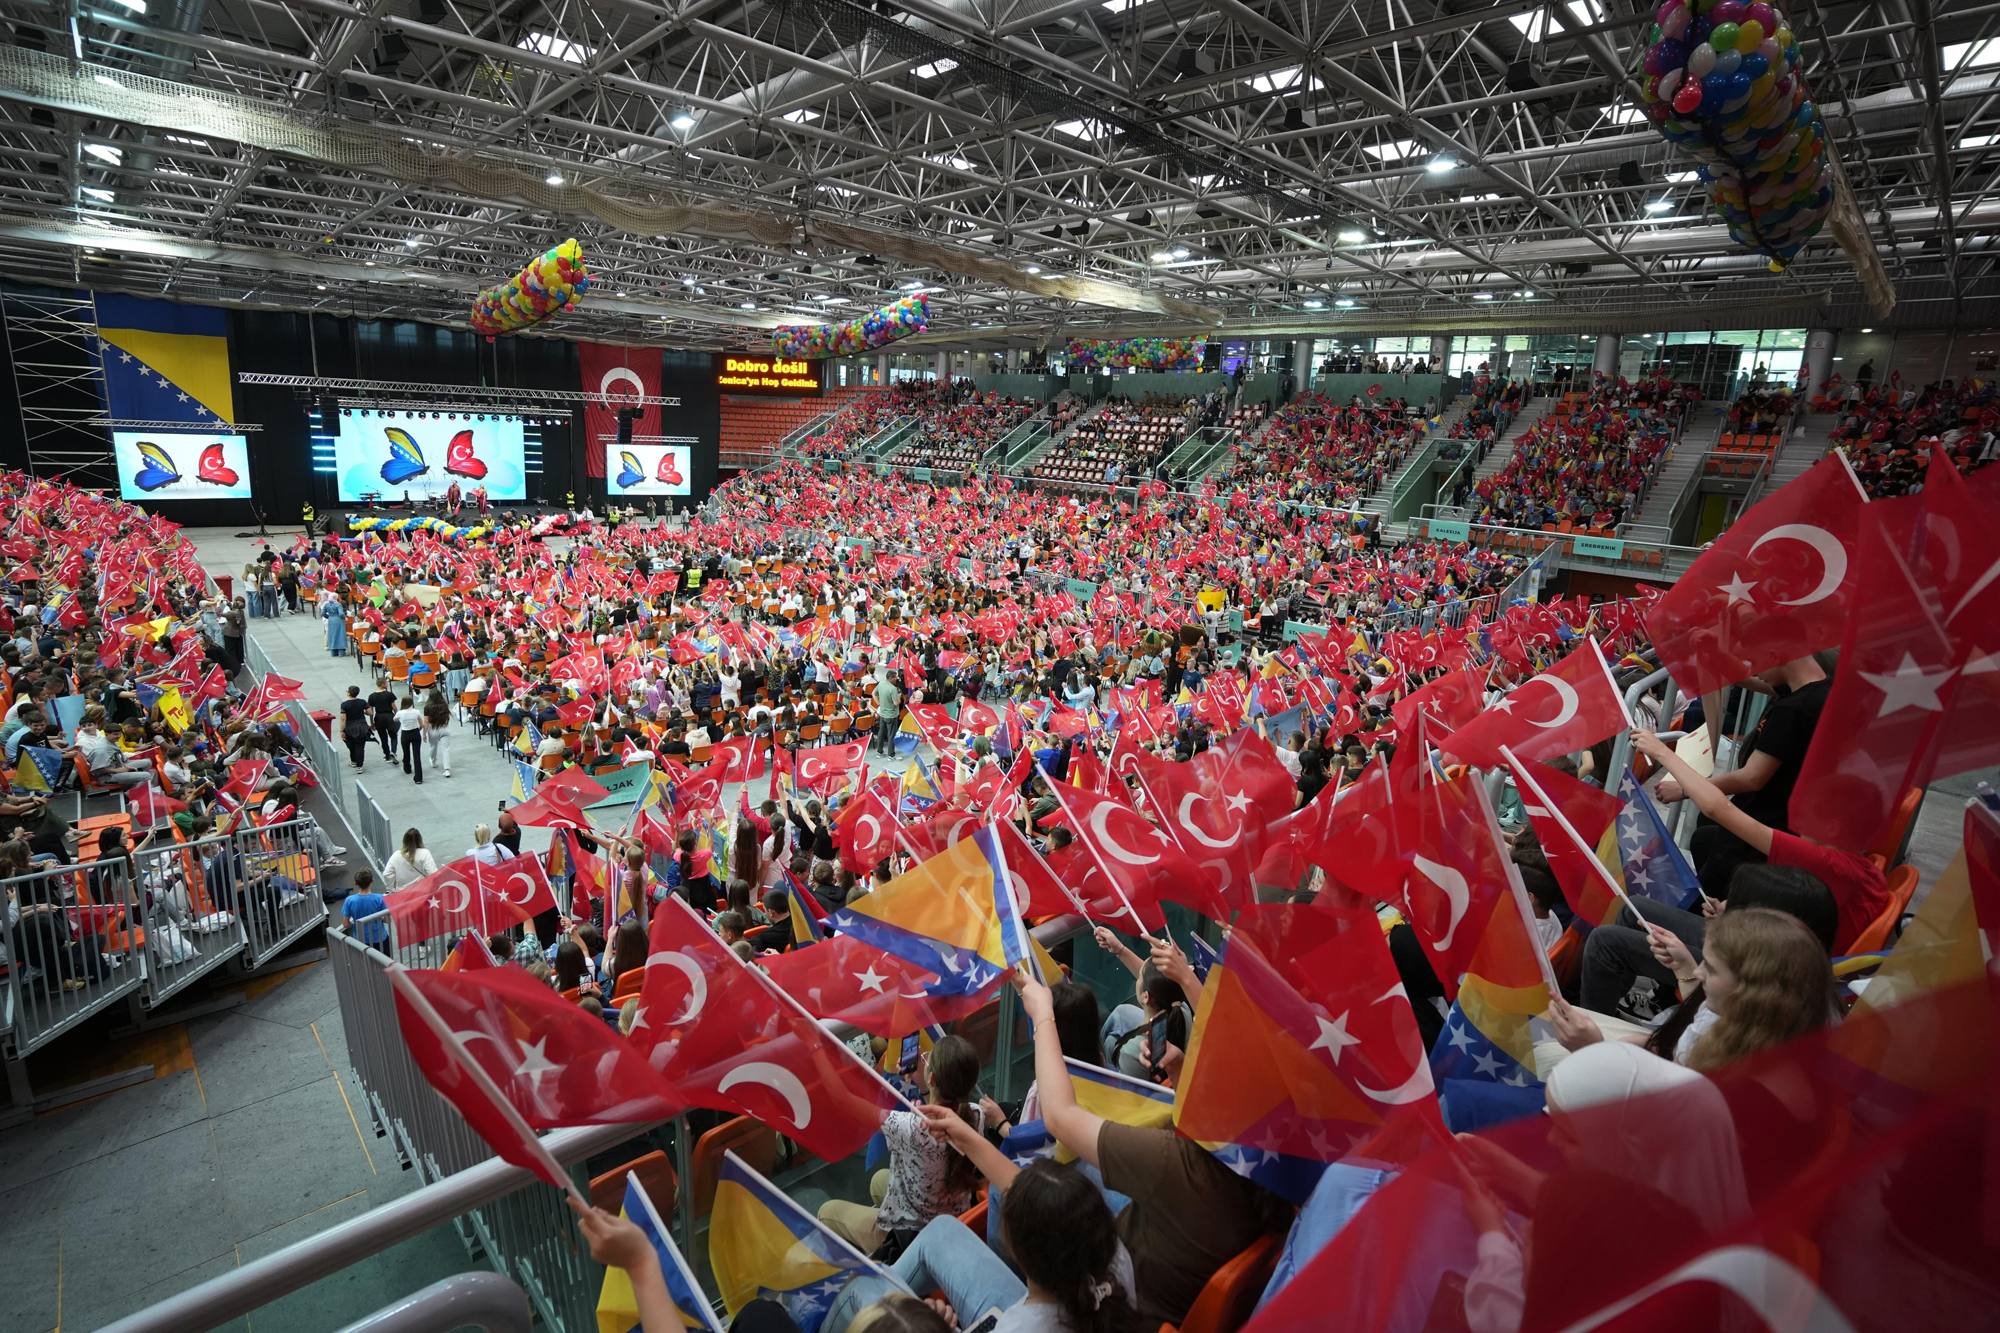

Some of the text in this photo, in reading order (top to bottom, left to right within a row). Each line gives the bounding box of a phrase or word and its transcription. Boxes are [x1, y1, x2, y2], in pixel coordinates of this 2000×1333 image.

[727, 360, 807, 374] Dobro došli
[762, 378, 779, 388] Hoş
[781, 379, 818, 388] Geldiniz
[1581, 543, 1616, 551] SREBRENIK
